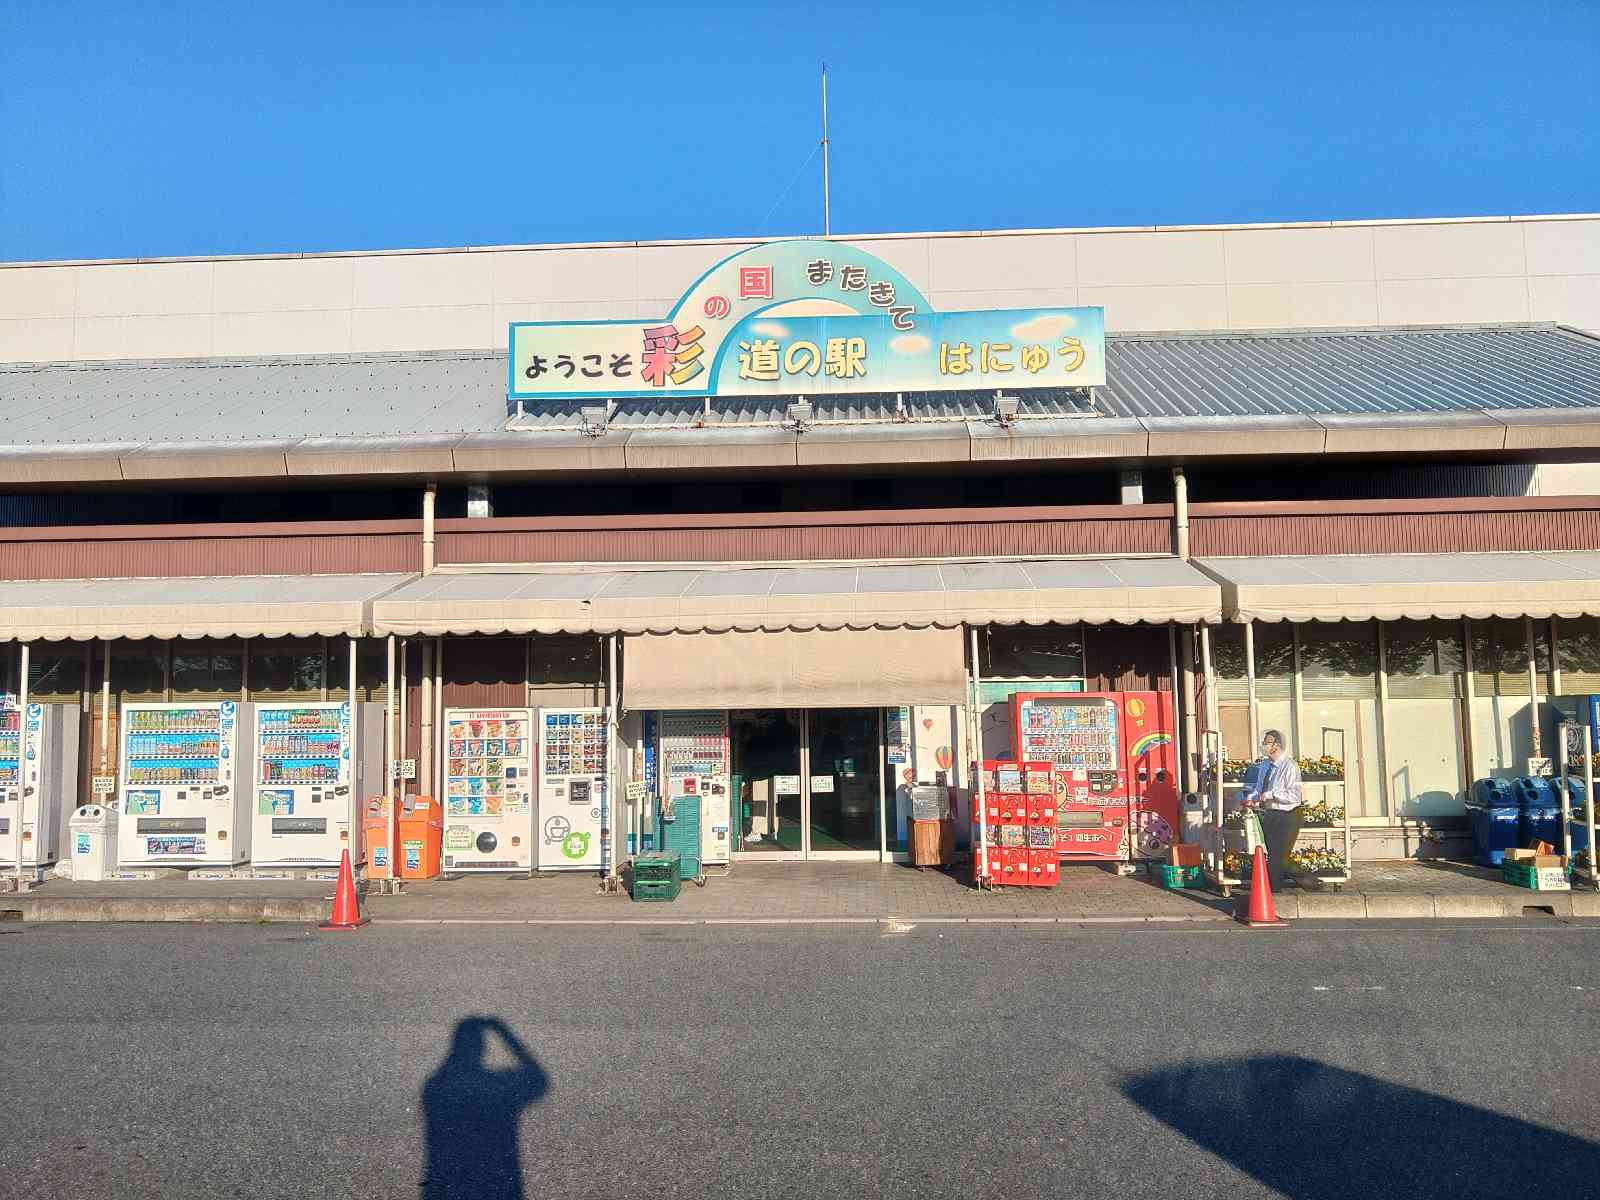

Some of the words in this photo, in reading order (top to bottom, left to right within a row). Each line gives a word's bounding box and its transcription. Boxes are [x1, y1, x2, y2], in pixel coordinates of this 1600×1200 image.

[807, 259, 916, 330] またきて
[525, 353, 632, 379] ようこそ
[738, 337, 867, 380] 道の駅
[939, 336, 1086, 374] はにゅう
